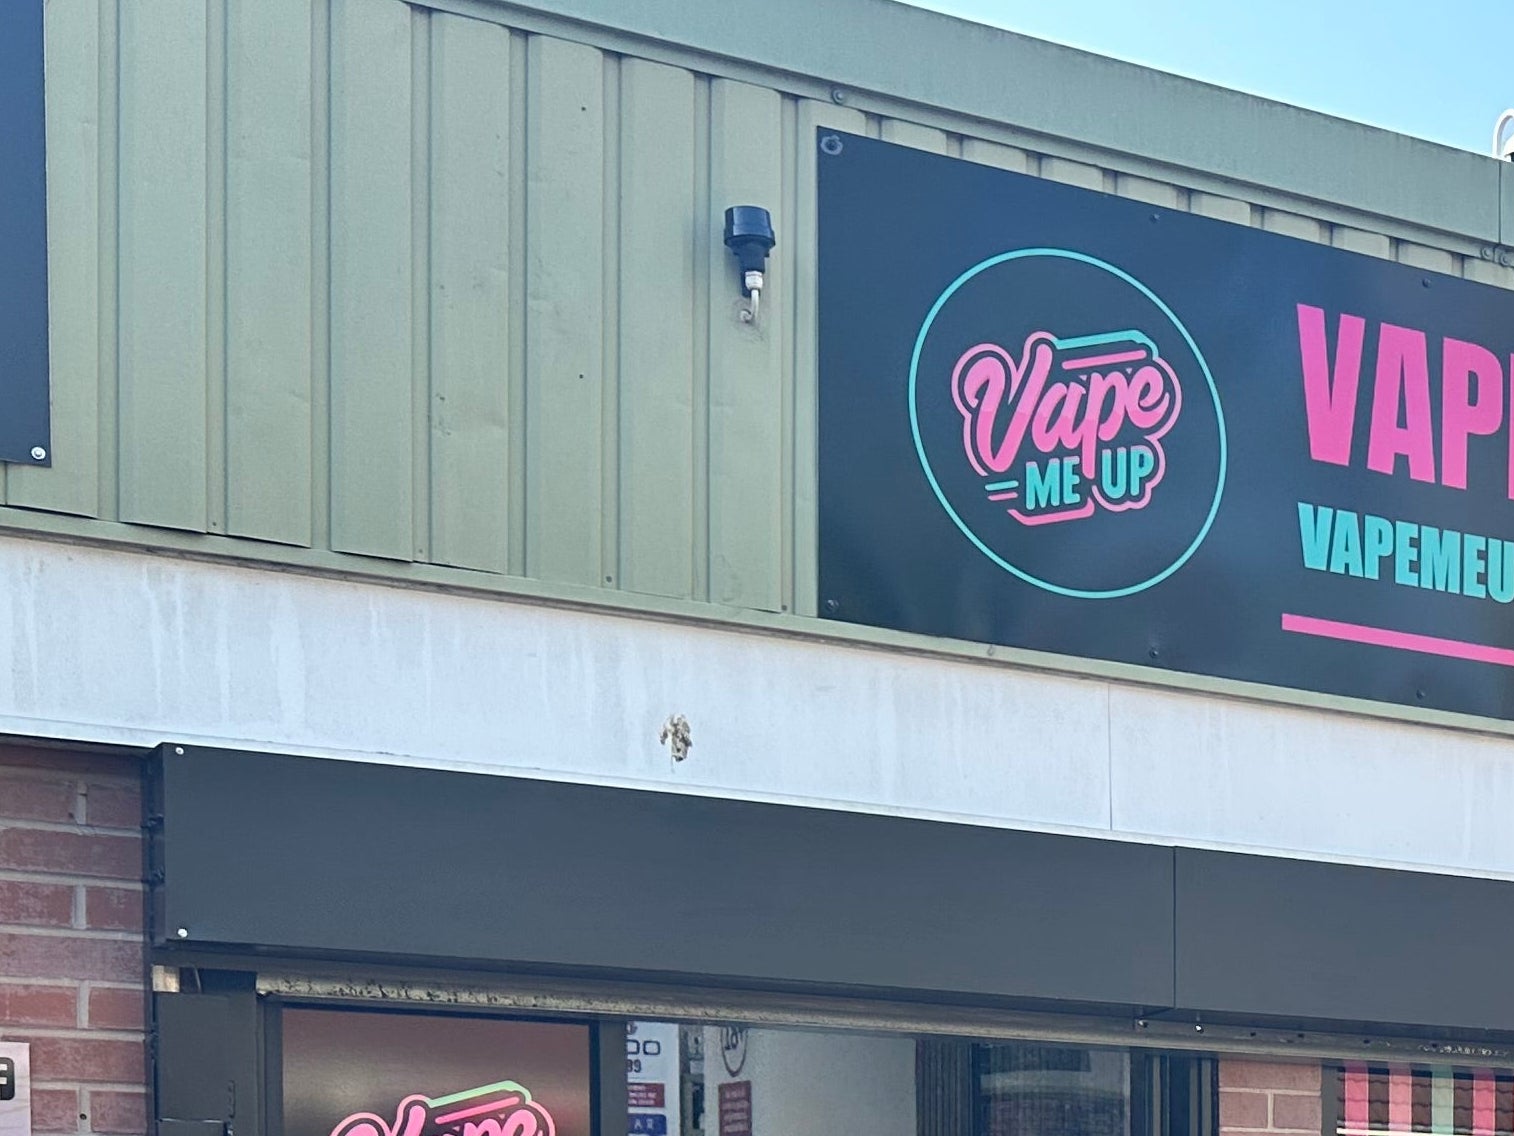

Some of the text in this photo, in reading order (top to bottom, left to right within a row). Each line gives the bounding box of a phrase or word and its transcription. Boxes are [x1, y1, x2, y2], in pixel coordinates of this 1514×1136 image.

[964, 344, 1169, 479] Vape
[1025, 445, 1154, 510] ME UP
